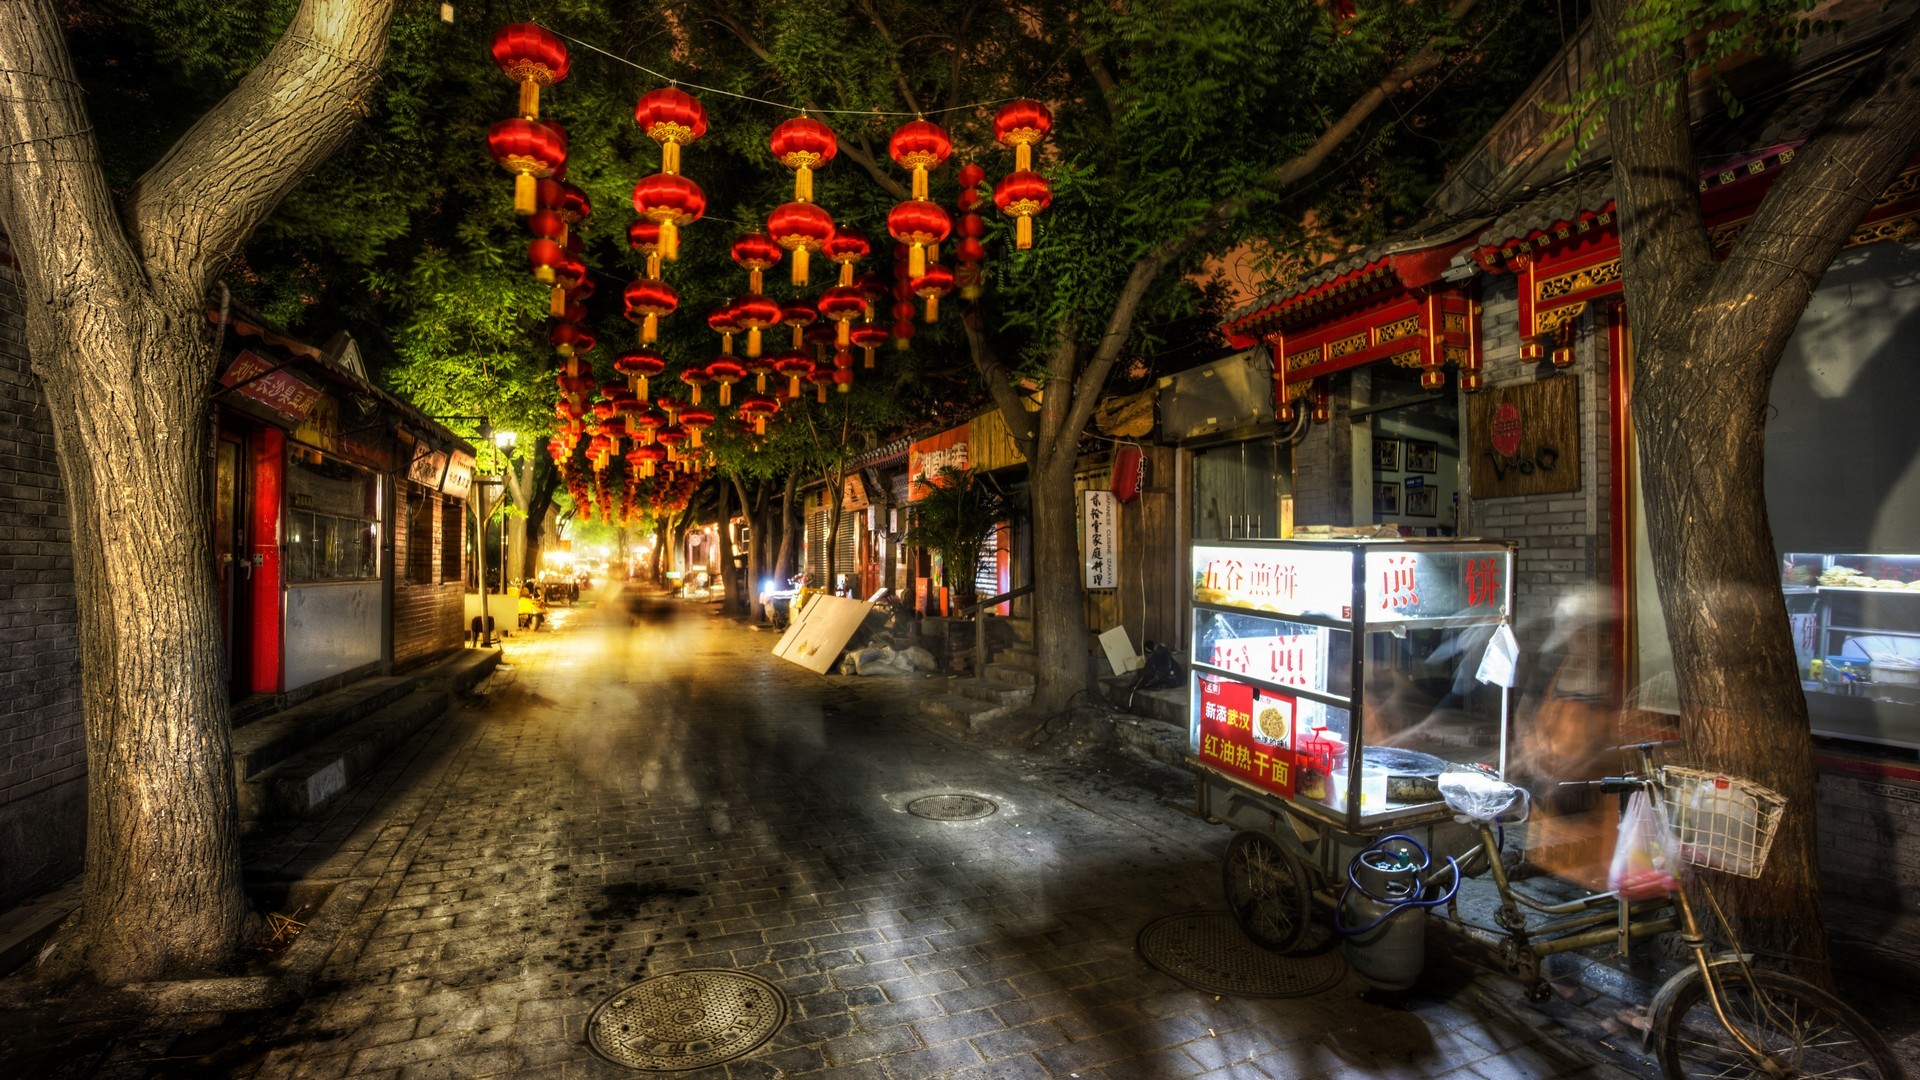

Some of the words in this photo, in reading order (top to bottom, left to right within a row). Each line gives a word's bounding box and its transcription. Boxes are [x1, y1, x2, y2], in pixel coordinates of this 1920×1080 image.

[1204, 559, 1299, 600] 五谷煎饼
[1205, 701, 1251, 731] 新添武汉
[1204, 733, 1290, 787] 红油热干面
